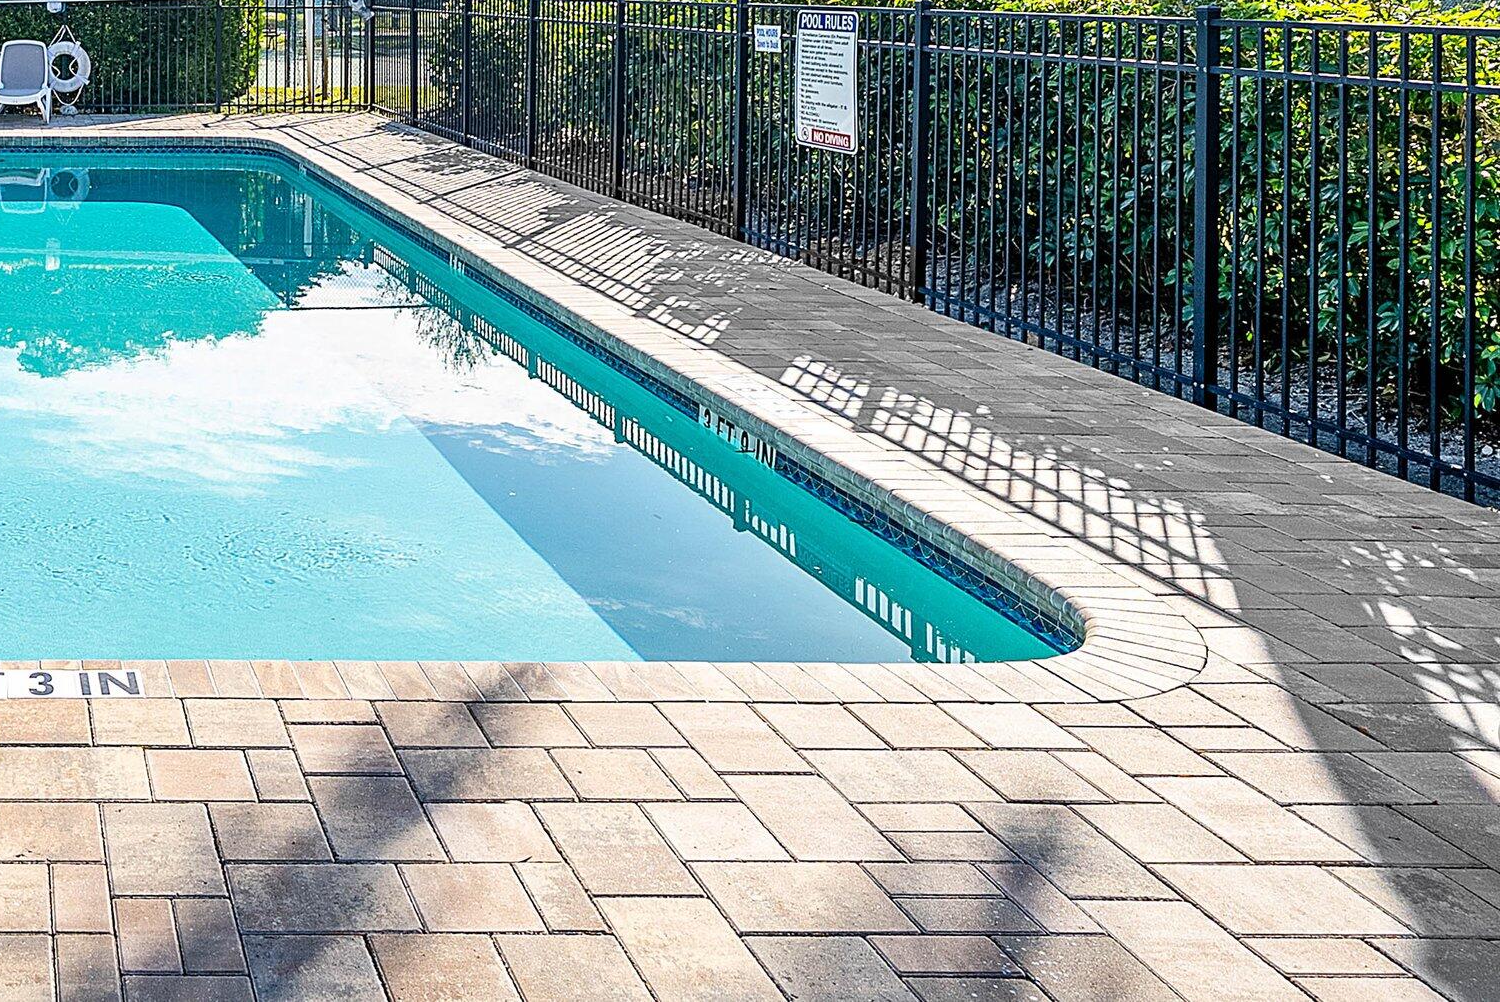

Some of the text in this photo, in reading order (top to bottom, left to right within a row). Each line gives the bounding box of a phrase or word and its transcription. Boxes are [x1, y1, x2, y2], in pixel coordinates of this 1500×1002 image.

[801, 13, 853, 31] POOL RULES
[813, 131, 849, 147] NO DIVING
[703, 408, 712, 429] 3
[716, 415, 736, 443] FT
[755, 438, 776, 469] IN
[28, 671, 55, 696] 3
[79, 671, 140, 696] IN
